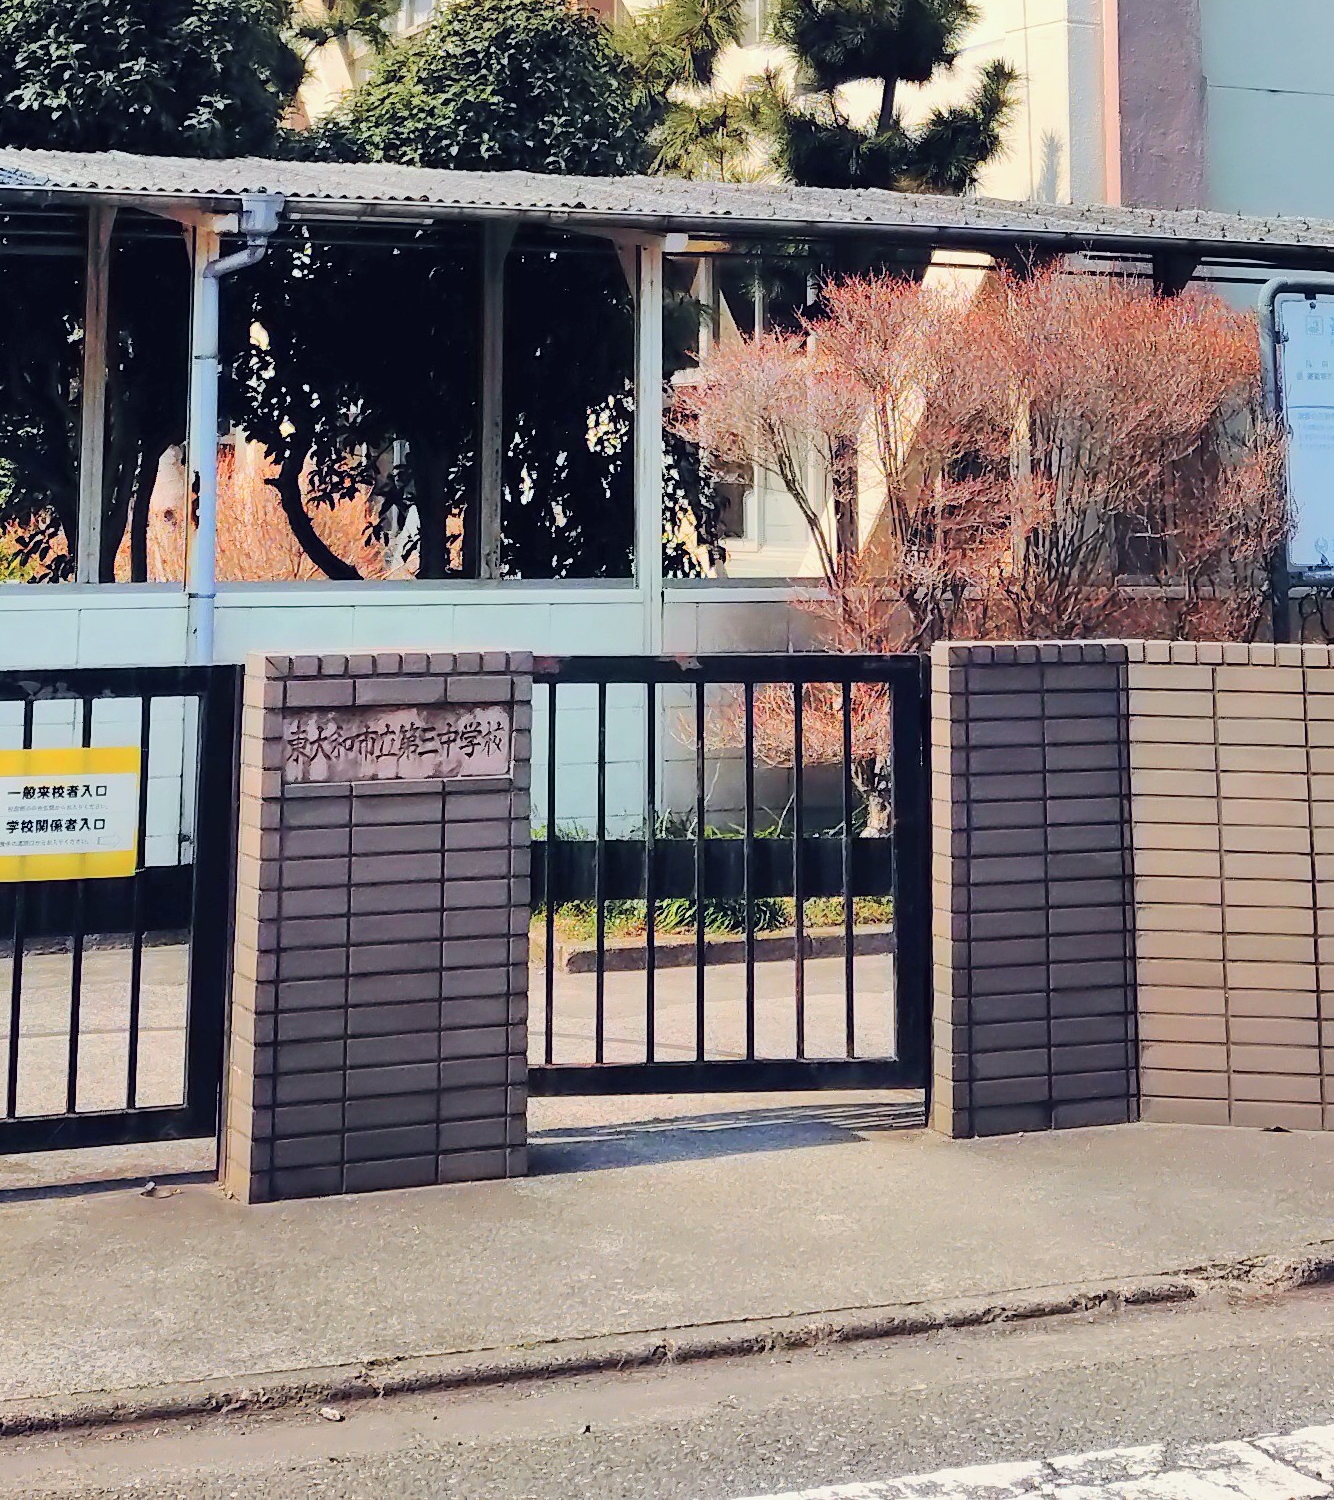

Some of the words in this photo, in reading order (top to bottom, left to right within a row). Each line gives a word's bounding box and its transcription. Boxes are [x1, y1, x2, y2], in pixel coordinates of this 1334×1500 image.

[7, 785, 108, 800] 一般来校者入口
[5, 818, 106, 834] 学校関係者入口
